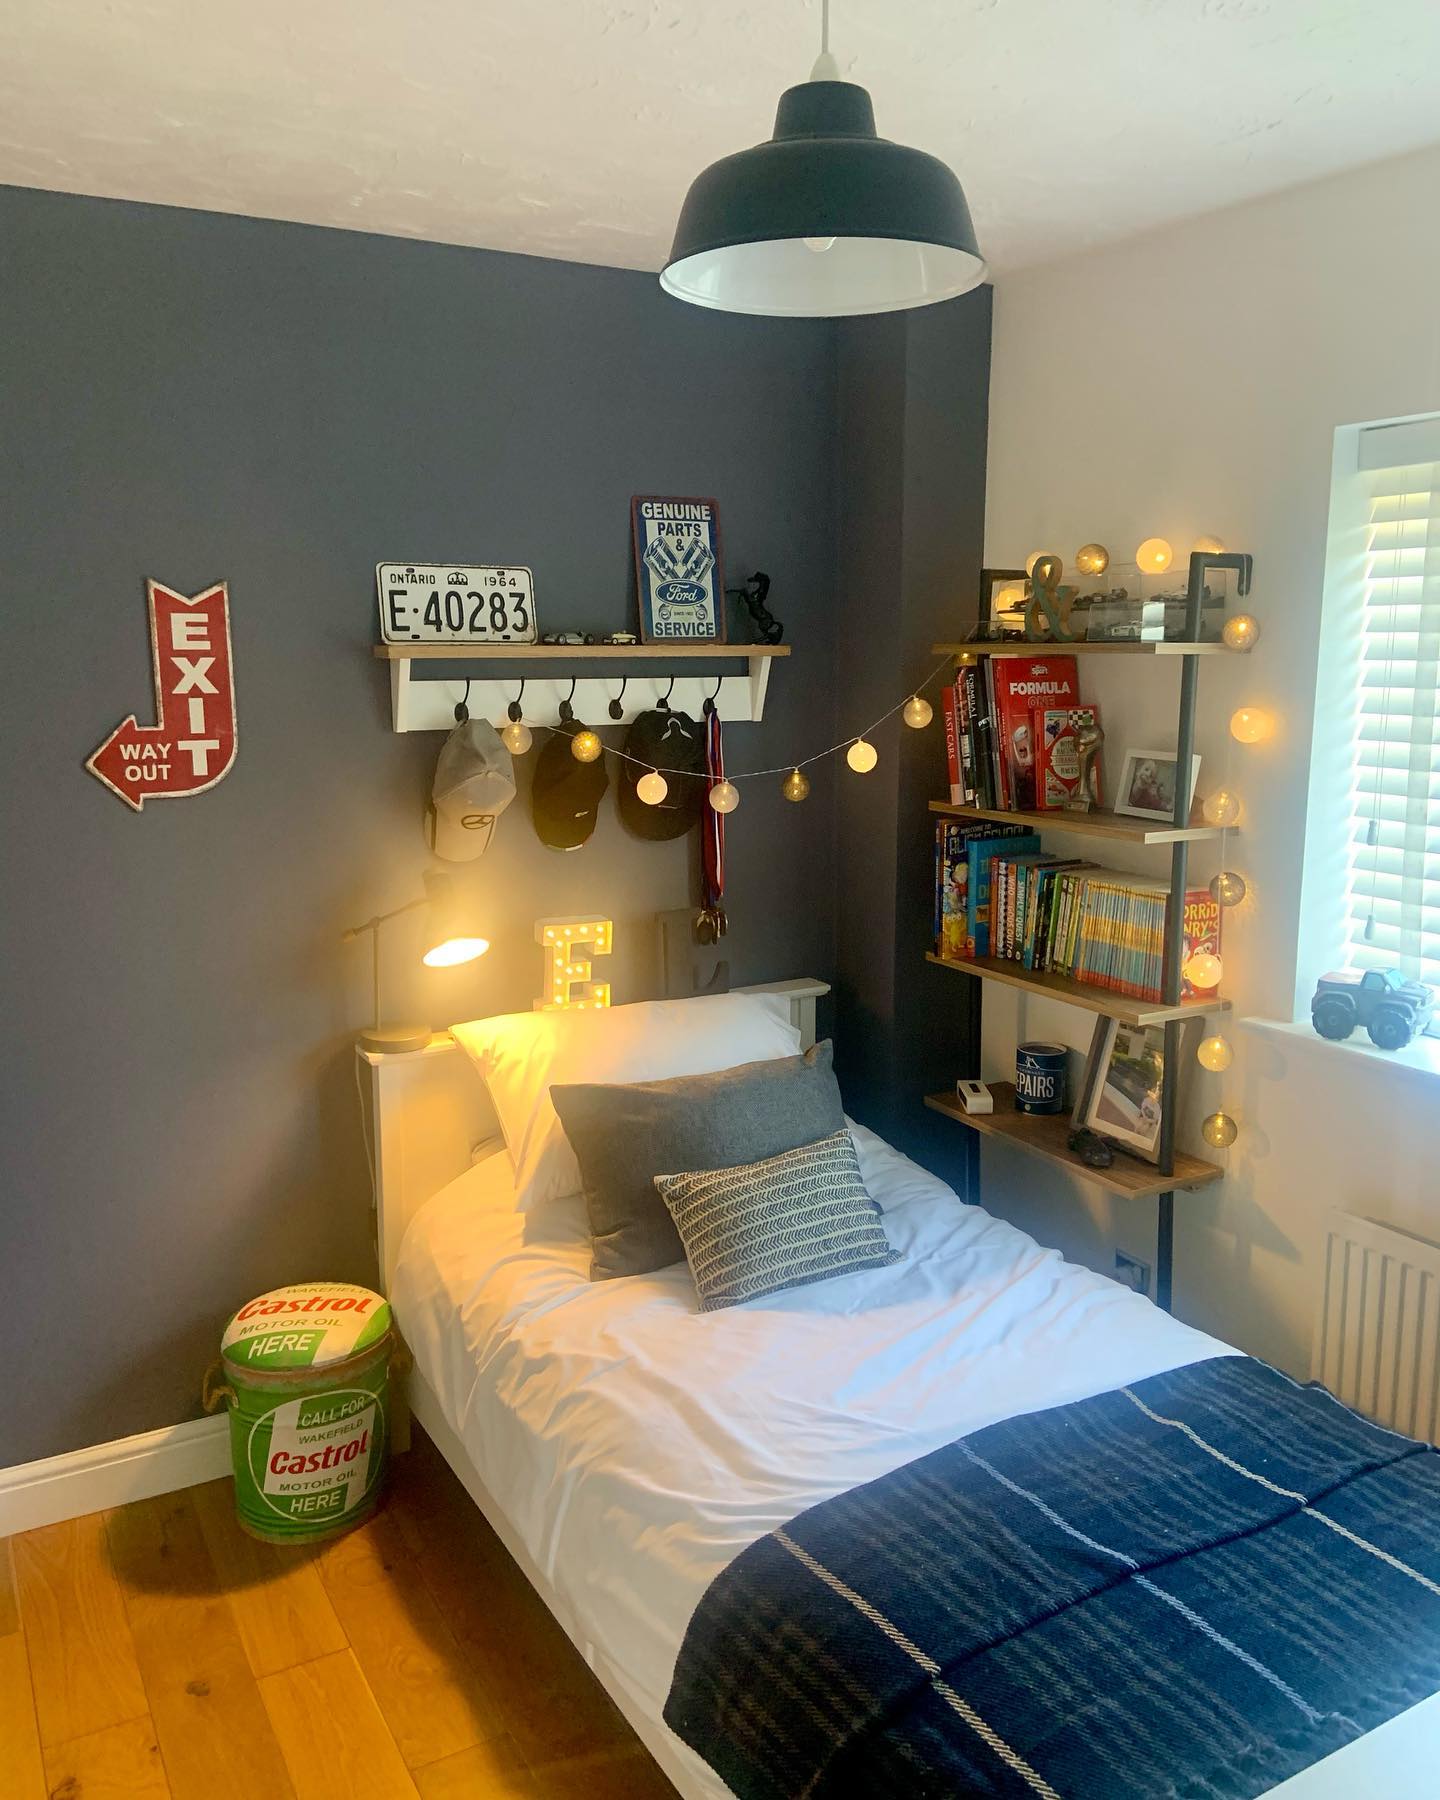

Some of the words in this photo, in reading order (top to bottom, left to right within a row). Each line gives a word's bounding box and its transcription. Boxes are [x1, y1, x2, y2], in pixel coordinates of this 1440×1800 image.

[641, 502, 712, 521] GENUINE
[657, 521, 702, 537] PARTS
[675, 538, 685, 552] &
[389, 573, 436, 585] ONTARIO
[484, 576, 517, 587] 1964
[666, 583, 699, 602] Ford
[655, 622, 715, 637] SERVICE
[170, 612, 220, 776] EXIT
[967, 673, 977, 712] FORMULA
[1009, 681, 1071, 696] FORMULA
[1027, 696, 1055, 708] ONE
[945, 711, 954, 732] FAST
[120, 743, 172, 760] WAY
[946, 735, 955, 760] CARS
[125, 764, 171, 782] OUT
[1007, 876, 1015, 896] WHO
[1017, 881, 1025, 911] SIMPLY
[1015, 917, 1024, 943] QUEST
[236, 1296, 373, 1322] Castrol
[239, 1318, 308, 1336] MOTOR
[313, 1317, 344, 1328] OIL
[248, 1333, 315, 1360] HERE
[301, 1406, 339, 1427] CALL
[340, 1396, 366, 1417] FOR
[298, 1418, 364, 1445] WAKEFIELD
[270, 1430, 369, 1475] Castrol
[279, 1477, 332, 1492] MOTOR
[337, 1471, 357, 1483] OIL
[290, 1491, 342, 1514] HERE
